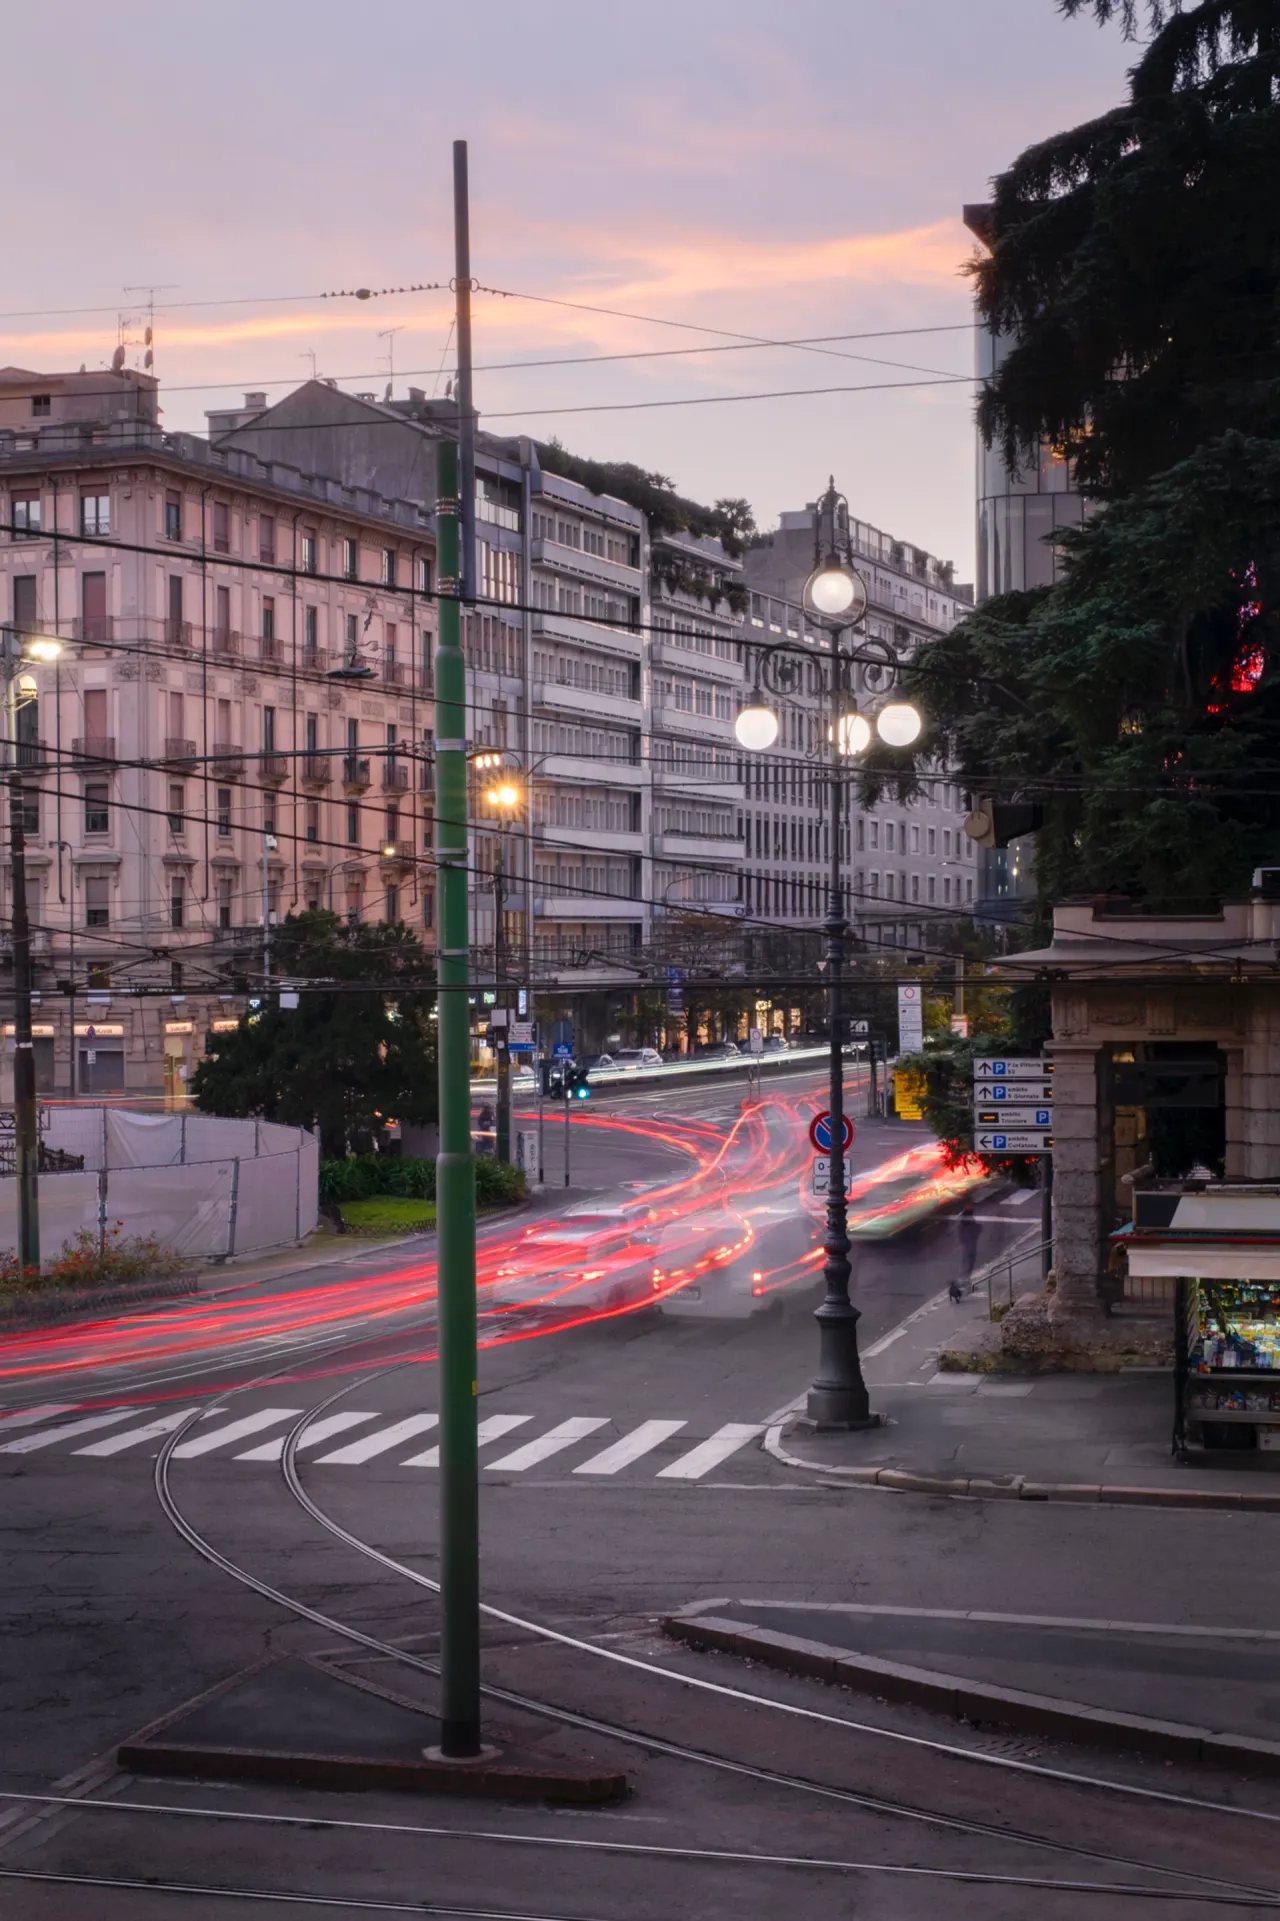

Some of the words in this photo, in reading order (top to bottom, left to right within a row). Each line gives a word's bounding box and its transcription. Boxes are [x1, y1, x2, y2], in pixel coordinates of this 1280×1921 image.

[995, 1063, 1004, 1074] P
[996, 1087, 1005, 1098] P
[1038, 1111, 1047, 1123] P
[996, 1137, 1005, 1147] P
